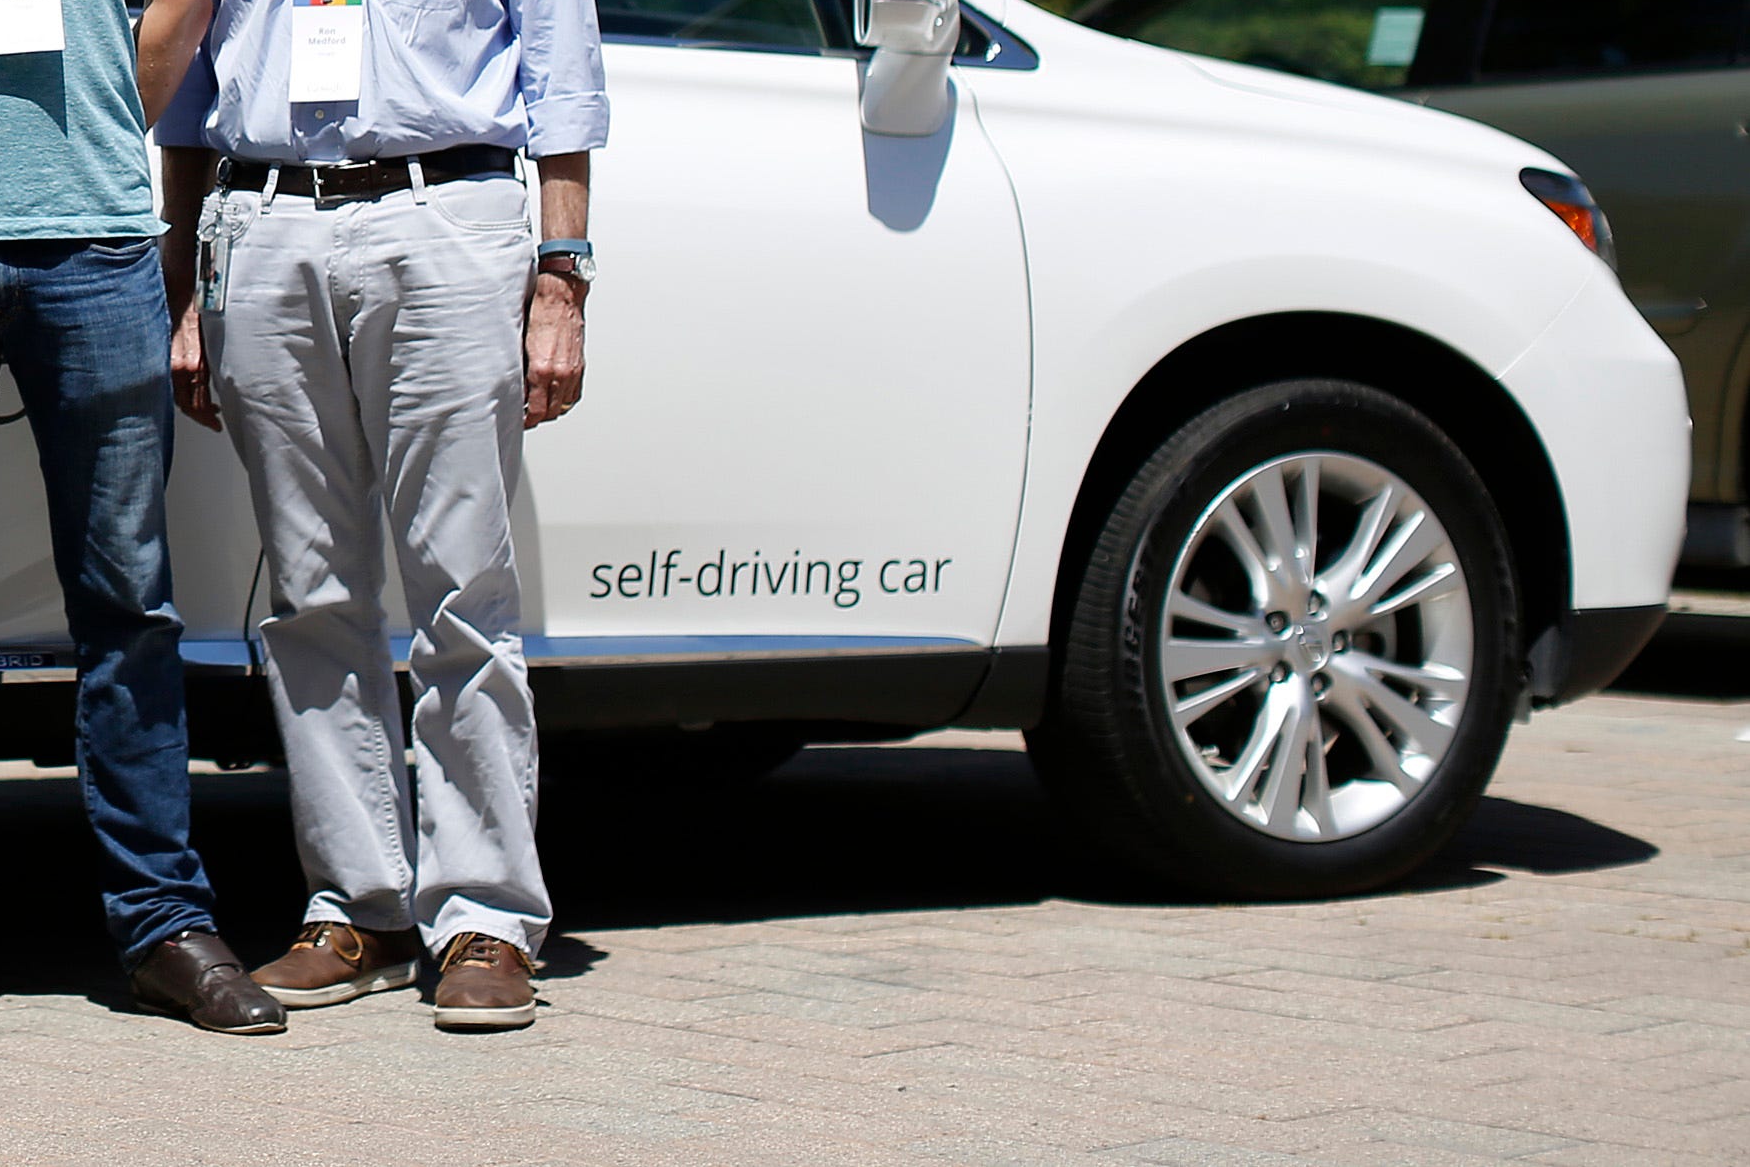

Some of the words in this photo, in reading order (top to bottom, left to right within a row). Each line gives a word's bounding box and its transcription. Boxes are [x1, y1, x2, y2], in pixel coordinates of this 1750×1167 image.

[308, 36, 346, 46] Medford
[589, 548, 864, 609] self-driving
[879, 556, 953, 594] car
